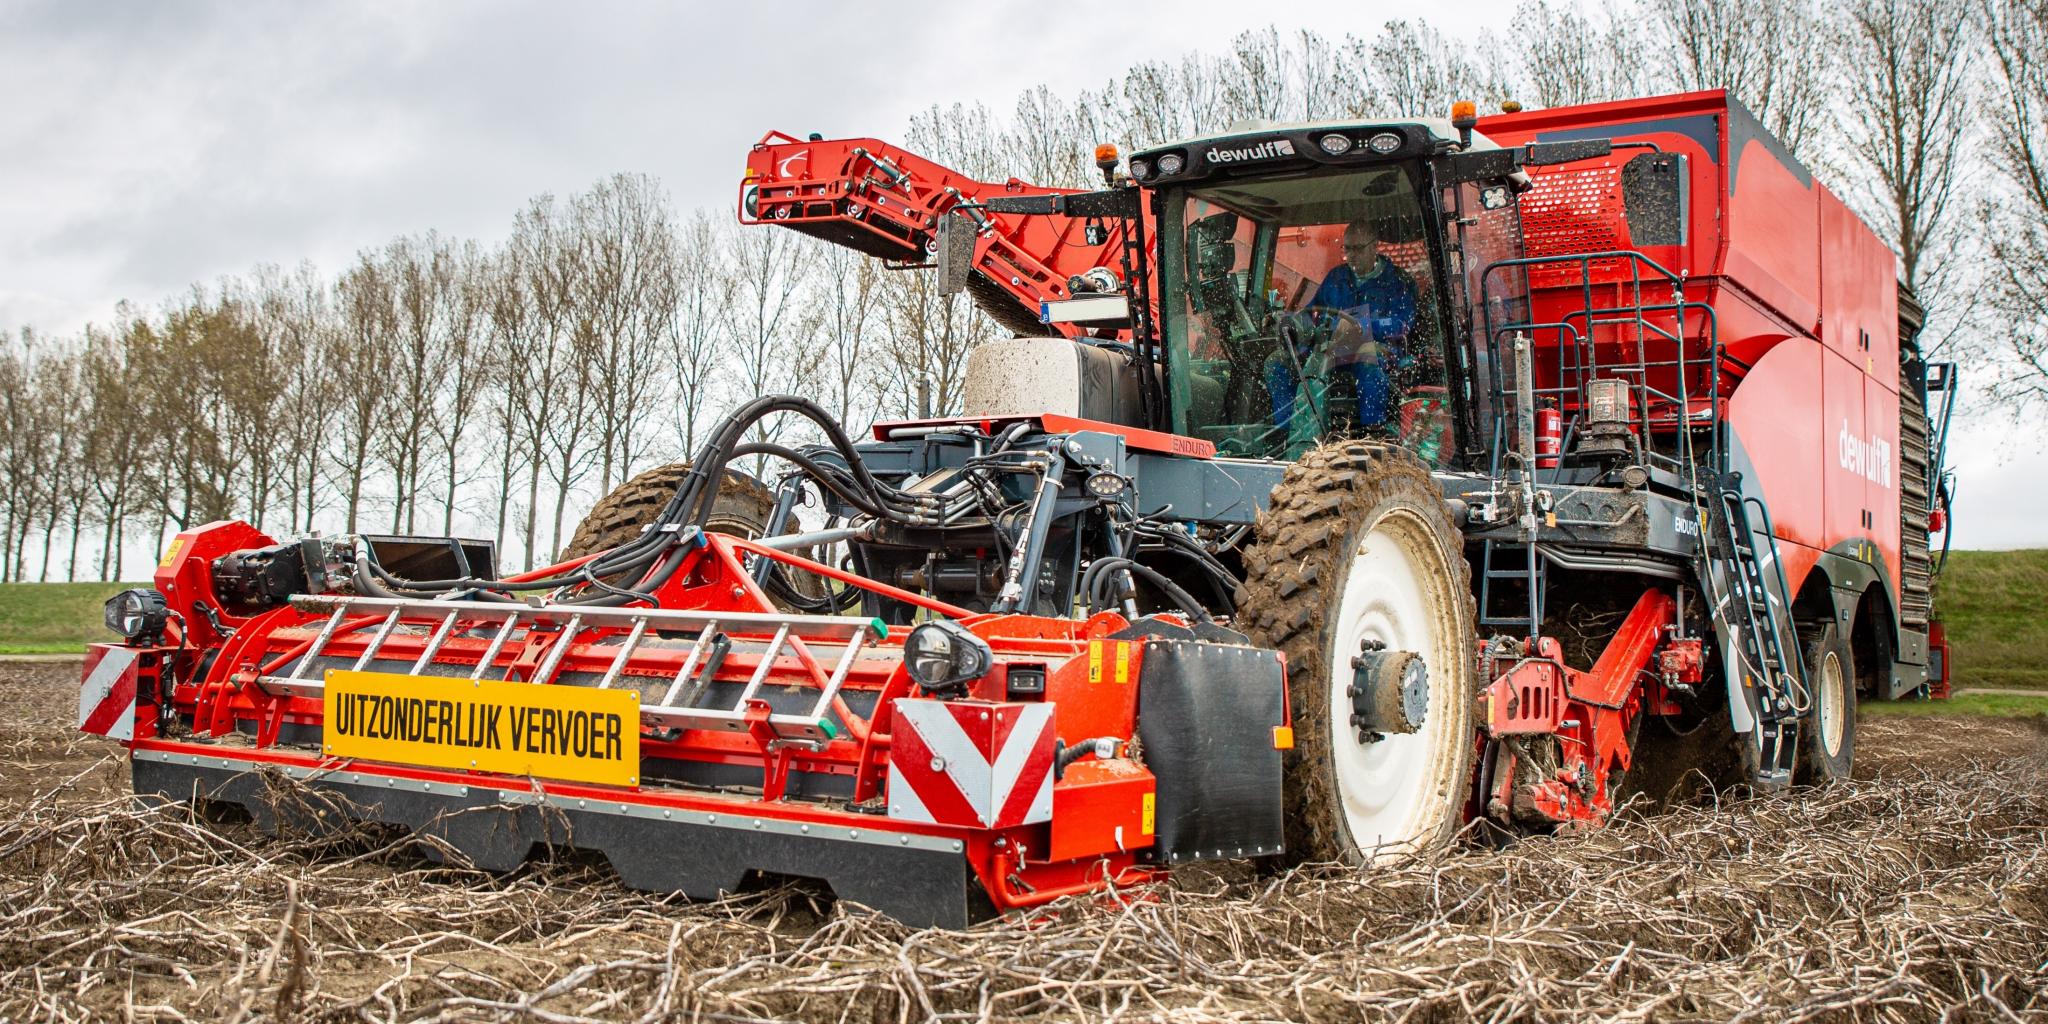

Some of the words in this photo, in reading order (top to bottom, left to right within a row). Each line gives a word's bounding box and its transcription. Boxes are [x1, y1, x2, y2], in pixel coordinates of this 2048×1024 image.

[1206, 141, 1275, 163] dewulf
[1172, 438, 1212, 457] ENDURO
[1839, 418, 1881, 486] dewulf
[1675, 516, 1699, 537] ENDURO
[336, 692, 502, 750] UITZONDERLIJK
[509, 706, 622, 760] VERVOER
